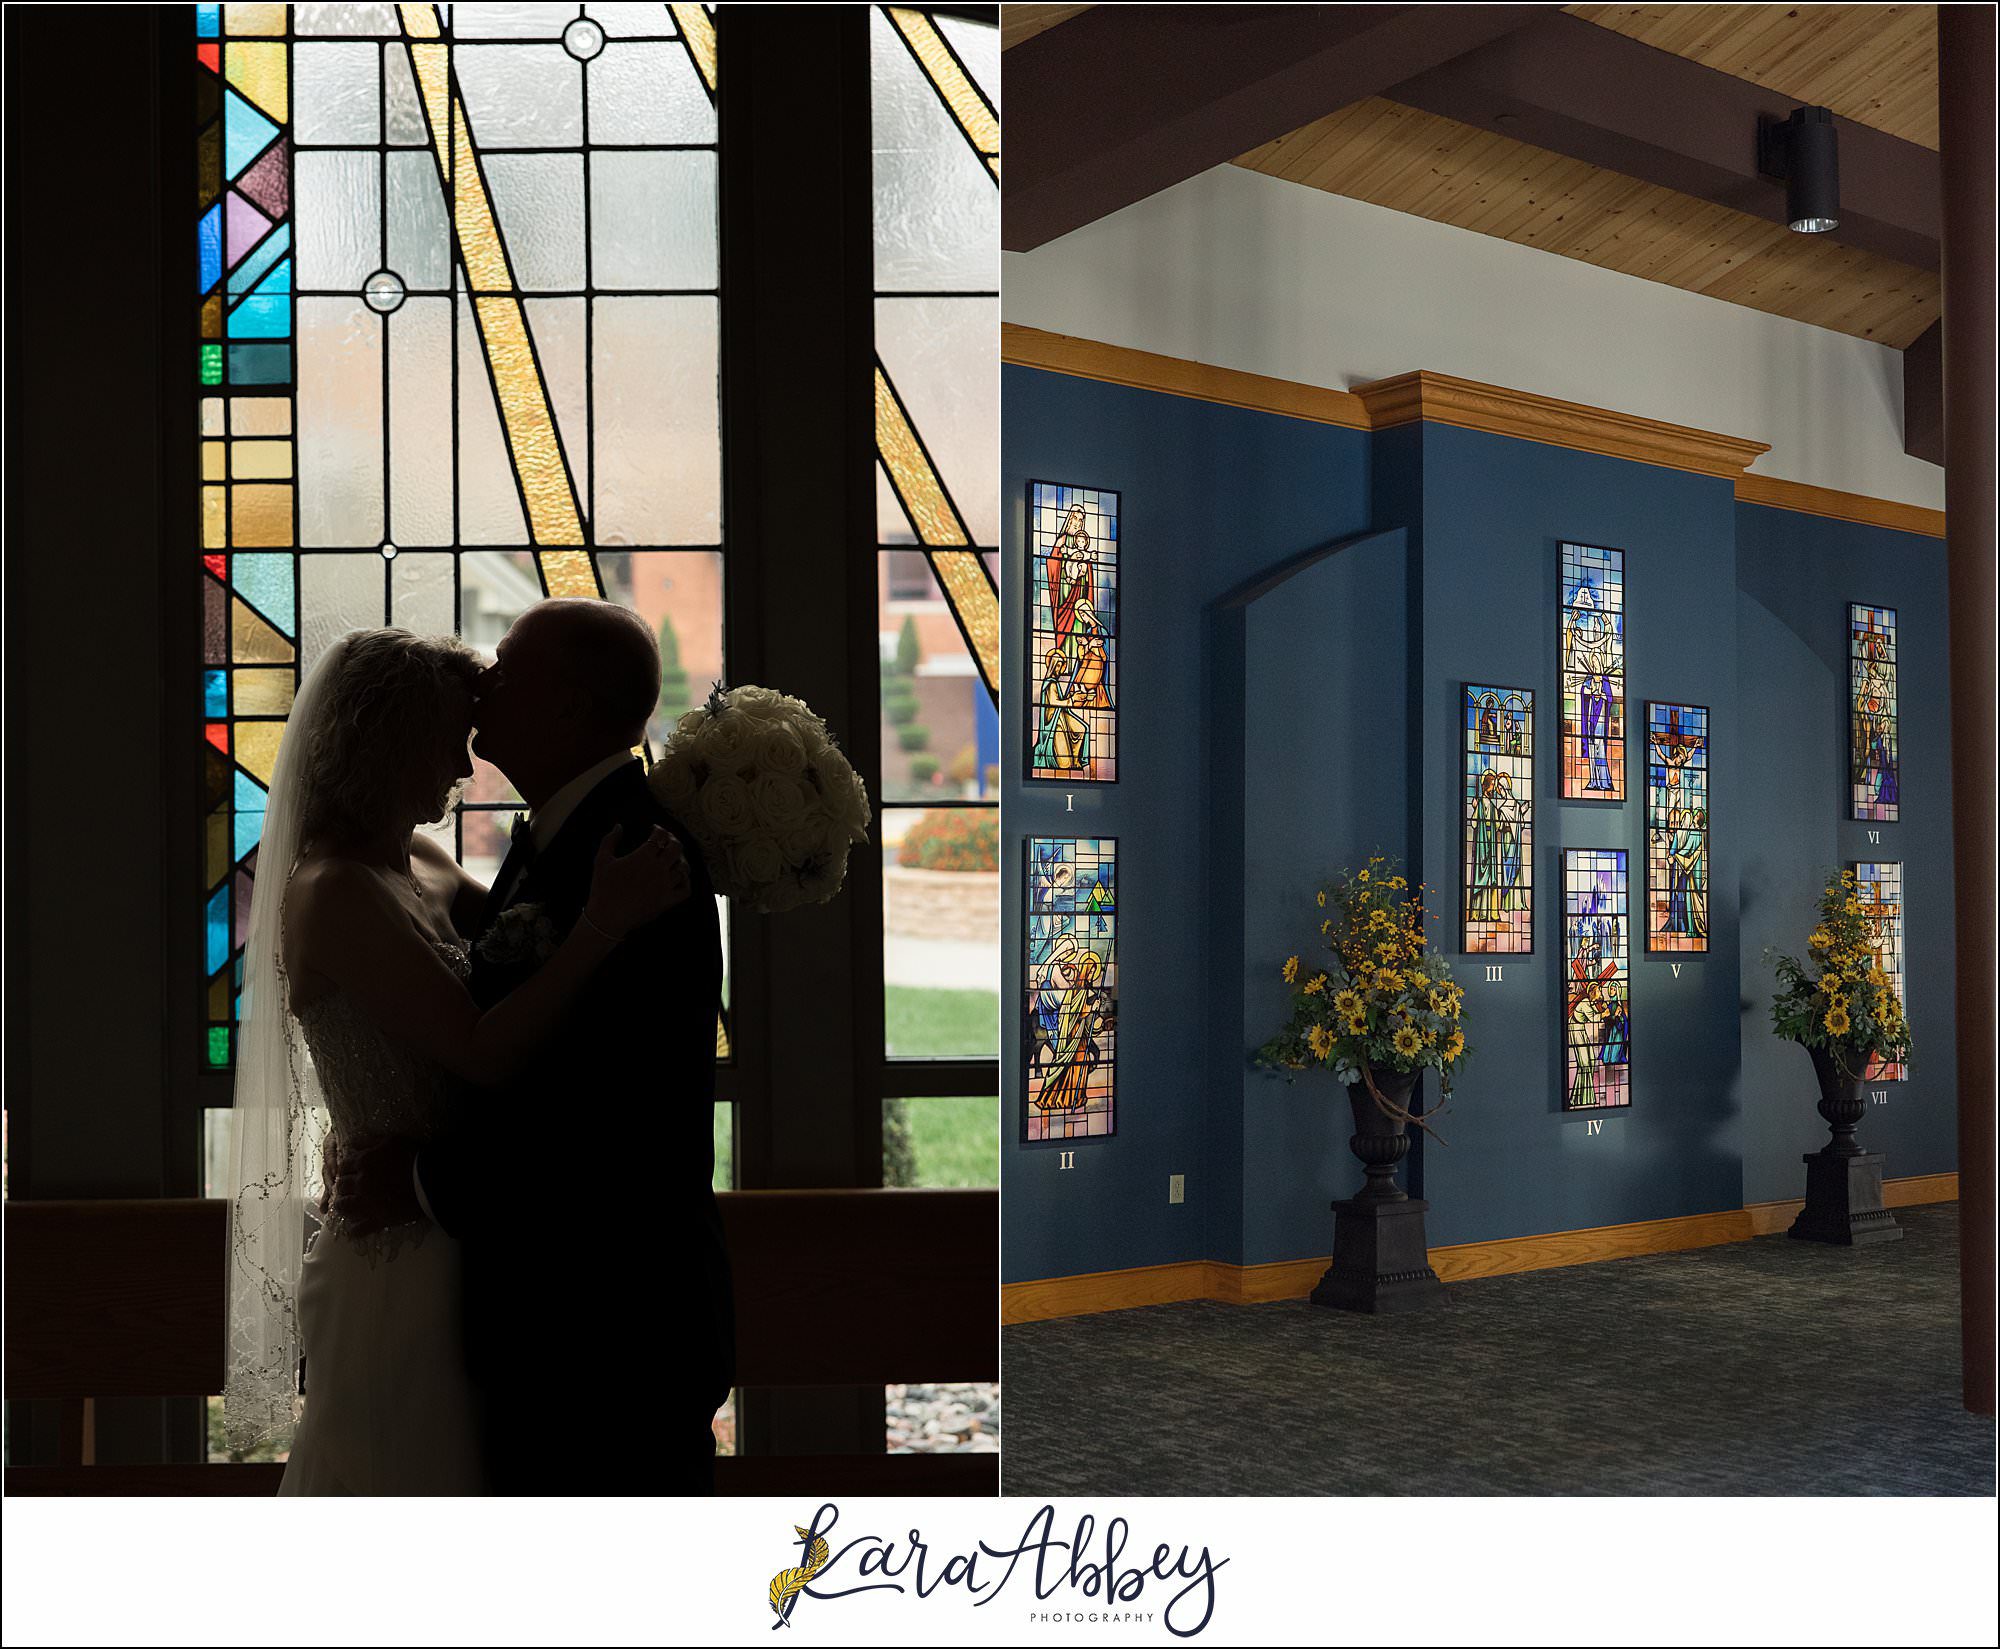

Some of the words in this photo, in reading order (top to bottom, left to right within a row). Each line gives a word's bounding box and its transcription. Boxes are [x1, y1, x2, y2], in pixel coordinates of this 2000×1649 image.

[1065, 794, 1075, 812] I
[1867, 830, 1881, 845] VI
[1485, 965, 1503, 982] III
[1671, 963, 1682, 979] V
[1871, 1091, 1888, 1105] VII
[1586, 1119, 1604, 1136] IV
[1058, 1151, 1075, 1170] II
